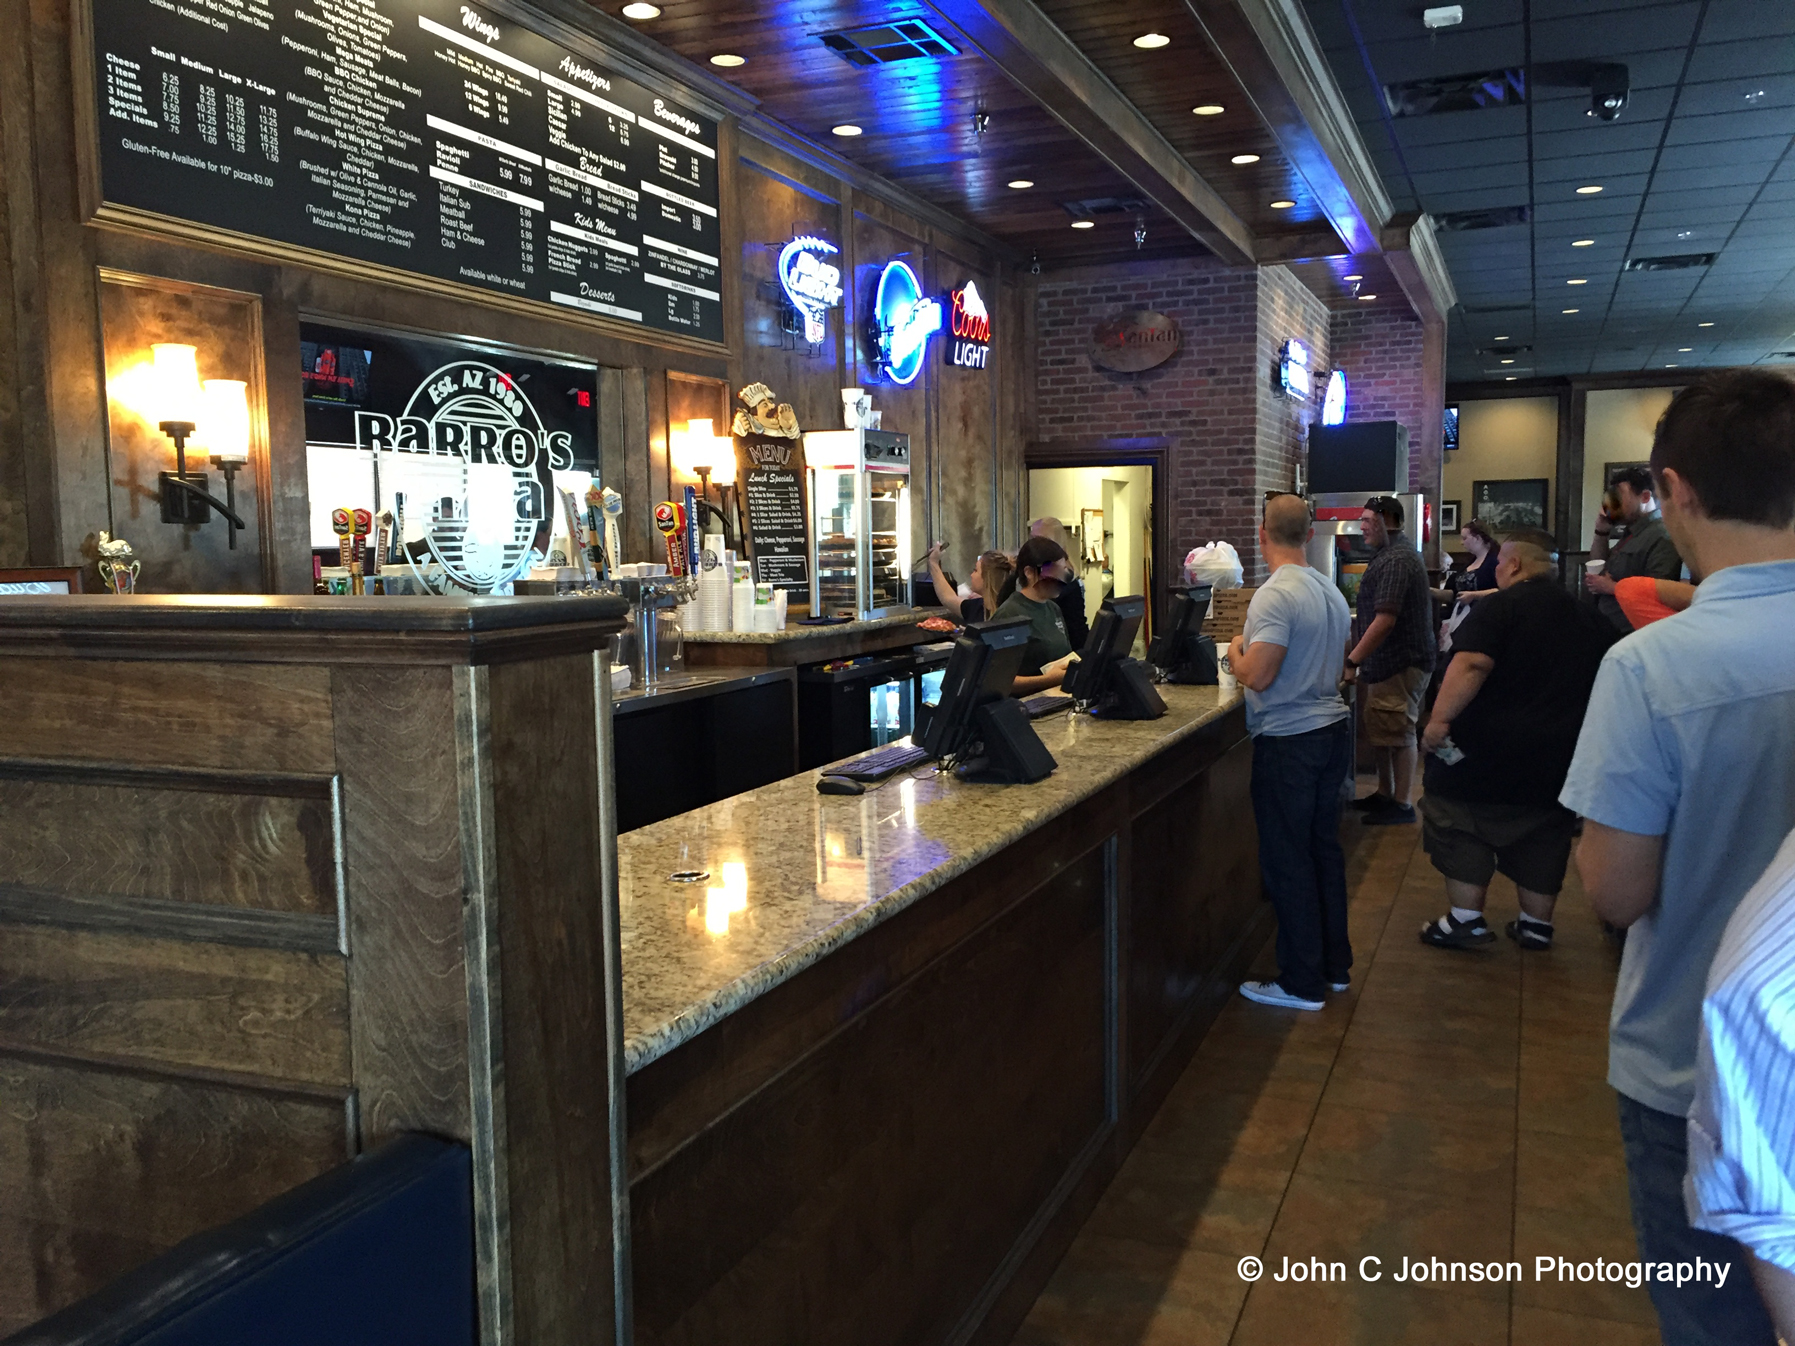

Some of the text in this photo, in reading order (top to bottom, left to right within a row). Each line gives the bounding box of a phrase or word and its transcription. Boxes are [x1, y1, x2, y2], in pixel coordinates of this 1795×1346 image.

[178, 5, 228, 32] (Additional Cost)
[219, 4, 235, 18] Onion
[237, 12, 252, 24] Green
[323, 10, 382, 41] Vegetarian Special
[460, 6, 500, 43] Wings
[151, 46, 276, 96] Small Medium Large X-Large
[336, 47, 373, 68] Mega Meats
[106, 53, 277, 117] Cheese 6.25 8.25 10.25 11.75
[335, 66, 377, 89] BBQ Chicken
[369, 70, 383, 82] Meat
[402, 82, 421, 97] Bacon)
[559, 55, 611, 92] Appetizers
[107, 64, 277, 127] 1 Item 7.00 9.25 11.50 13.25
[107, 75, 278, 136] 2 Items 7.75 10.25 12.75 14.75
[329, 96, 385, 122] Chicken Supreme
[108, 86, 114, 94] 3
[117, 88, 142, 102] Items
[163, 102, 179, 113] 8.50
[197, 113, 216, 125] 11.25
[227, 123, 245, 134] 14.00
[653, 99, 701, 135] Beverages
[109, 97, 278, 154] Specials 9.25 12.25 15.25 17.75
[110, 109, 279, 162] Add. Items .75 1.00 1.25 1.50
[335, 129, 383, 151] Hot Wing Pizza
[436, 140, 470, 159] Spaghetti
[478, 135, 497, 147] PASTA
[122, 138, 170, 160] Gluten-Free
[171, 151, 206, 169] Available
[208, 161, 217, 172] for
[233, 169, 273, 187] pizza-$3.00
[300, 160, 329, 176] (Brushed
[339, 171, 355, 183] Olive
[342, 162, 379, 179] White Pizza
[436, 150, 460, 165] Ravioli
[499, 168, 512, 180] 5.99
[437, 159, 459, 172] Penne
[580, 156, 603, 176] Bread
[469, 180, 507, 198] SANDWICHES
[548, 174, 563, 186] Garlic
[564, 180, 578, 192] Bread
[581, 185, 591, 196] 1.00
[345, 204, 380, 220] Kona Pizza
[439, 181, 531, 218] Turkey 5.99
[439, 193, 532, 229] Italian Sub 5.99
[440, 204, 533, 240] Meatball 5.99
[440, 216, 533, 251] Roast Beef 5.99
[574, 212, 617, 236] Kids Menu
[441, 227, 533, 263] Ham & Cheese 5.99
[441, 238, 534, 274] Club 5.99
[460, 266, 526, 289] Available white or wheat
[579, 282, 615, 302] Desserts
[951, 289, 991, 342] Coors
[954, 341, 990, 369] LIGHT
[428, 370, 524, 417] Est. AZ 1980
[749, 444, 791, 464] MENU
[749, 473, 794, 484] Lunch Specials
